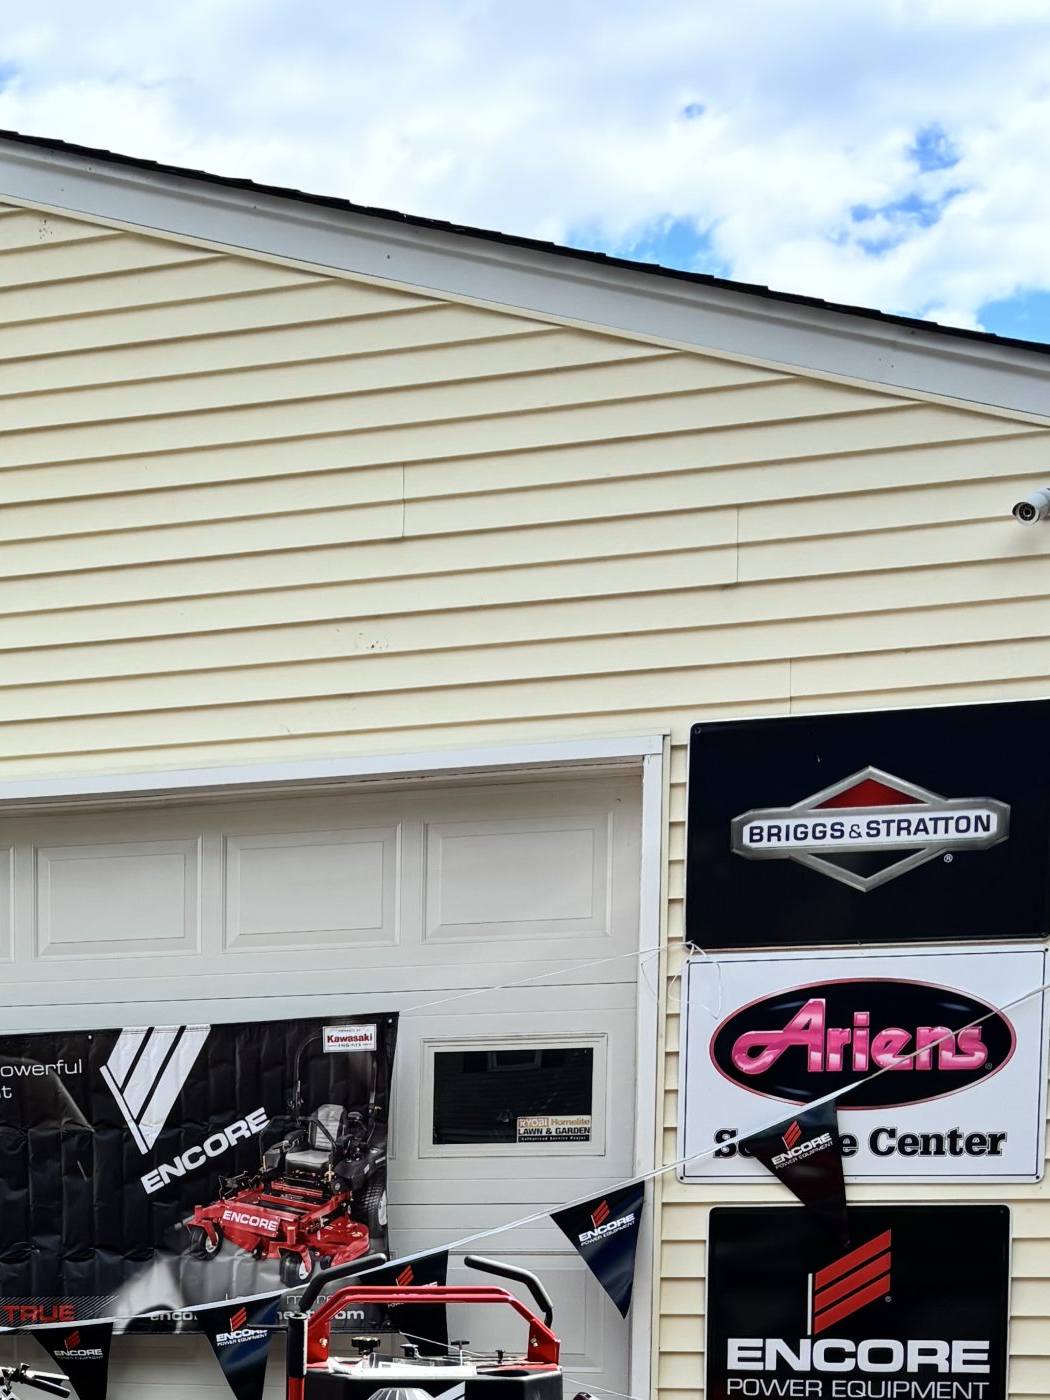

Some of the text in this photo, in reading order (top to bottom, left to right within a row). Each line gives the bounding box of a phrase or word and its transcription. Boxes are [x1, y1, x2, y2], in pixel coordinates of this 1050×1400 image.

[327, 1033, 373, 1043] Kawasaki
[731, 998, 988, 1075] Ariens
[519, 1117, 590, 1127] RYOBI Homelite
[555, 1127, 590, 1135] GARDEN
[140, 1107, 270, 1194] ENCORE
[771, 1132, 832, 1165] ENCORE
[775, 1157, 798, 1170] POWER
[798, 1141, 833, 1160] EQUIPMENT
[869, 1126, 1008, 1158] Center
[222, 1210, 279, 1231] ENCORE
[578, 1213, 635, 1242] ENCORE
[581, 1220, 635, 1246] POWER EQUIPMENT
[2, 1304, 76, 1322] TRUE
[727, 1338, 990, 1373] ENCORE
[727, 1378, 990, 1400] POWER EQUIPMENT
